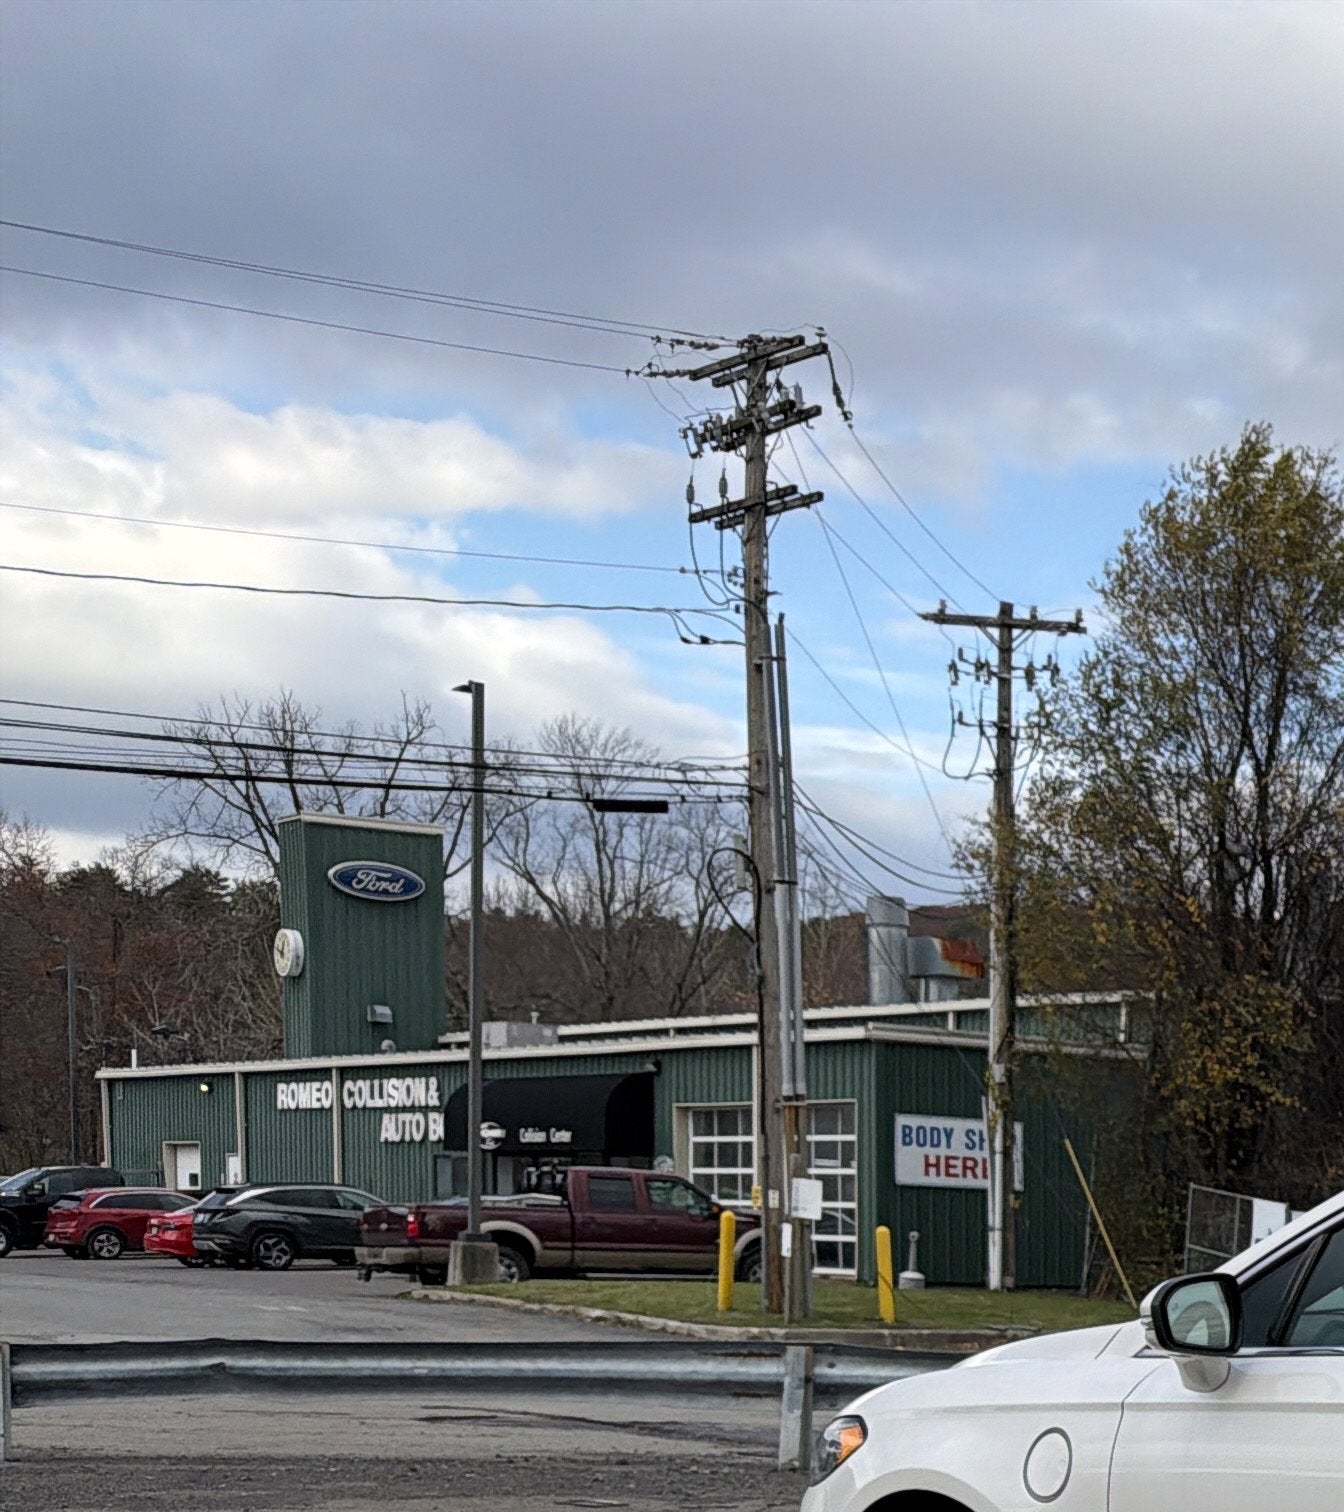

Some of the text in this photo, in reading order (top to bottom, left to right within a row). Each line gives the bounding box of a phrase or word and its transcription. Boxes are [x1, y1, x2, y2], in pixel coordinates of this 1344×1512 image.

[352, 869, 405, 893] Ford
[277, 1081, 332, 1110] ROMEO
[343, 1077, 426, 1108] COLLISION
[380, 1112, 425, 1142] AUTO
[901, 1124, 955, 1149] BODY
